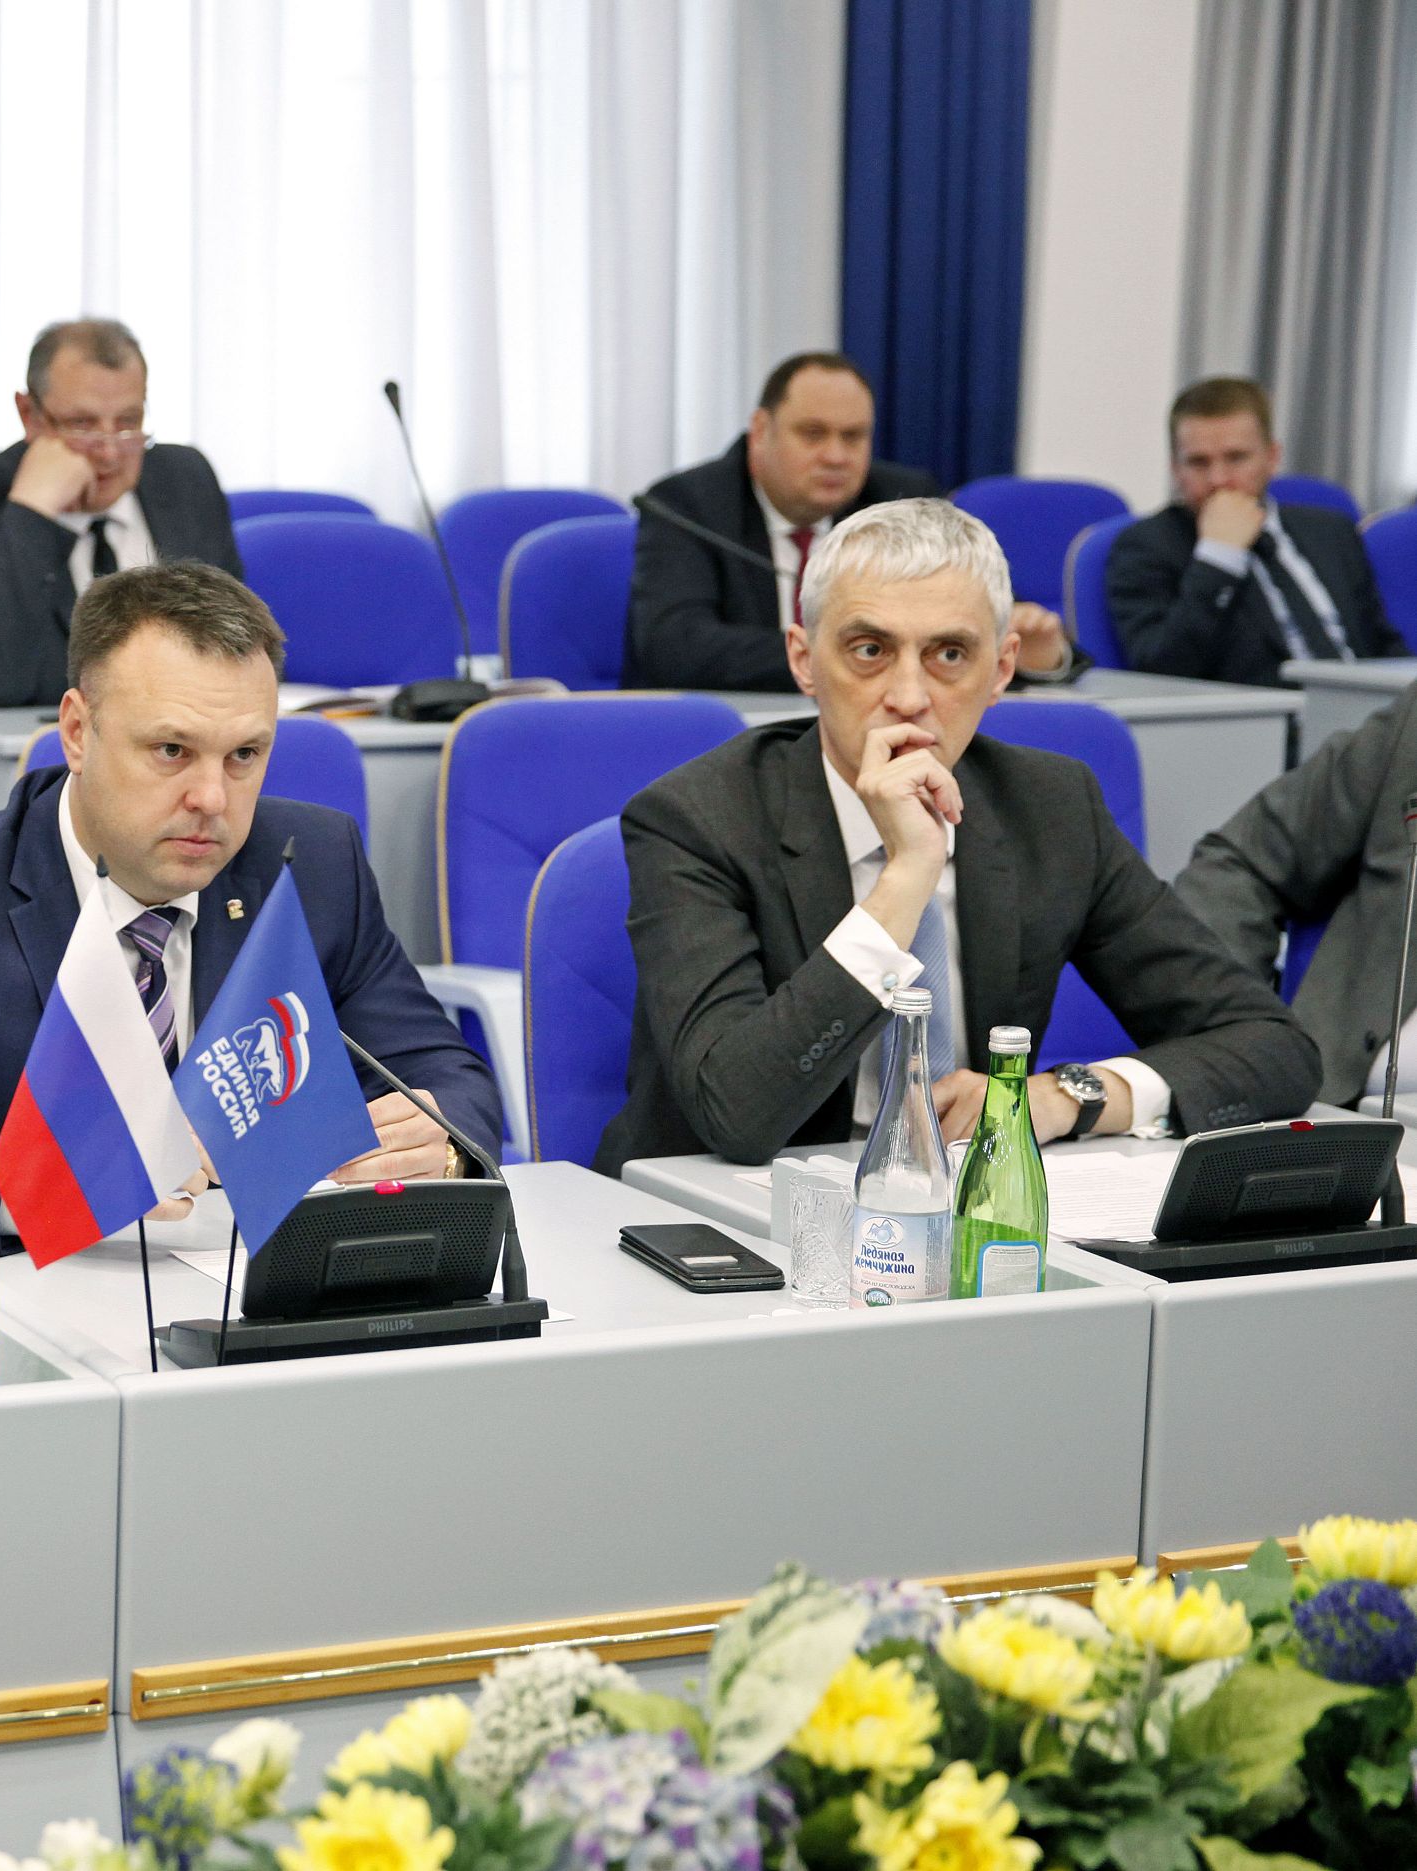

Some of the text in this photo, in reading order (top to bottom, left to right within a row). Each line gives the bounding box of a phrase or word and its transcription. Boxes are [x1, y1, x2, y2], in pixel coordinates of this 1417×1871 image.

[211, 1036, 261, 1127] ЕДИНАЯ
[196, 1050, 248, 1139] РОССИЯ
[860, 1244, 904, 1262] Ледяная
[1275, 1241, 1315, 1254] PHILIPS
[368, 1319, 414, 1334] PHILIPS
